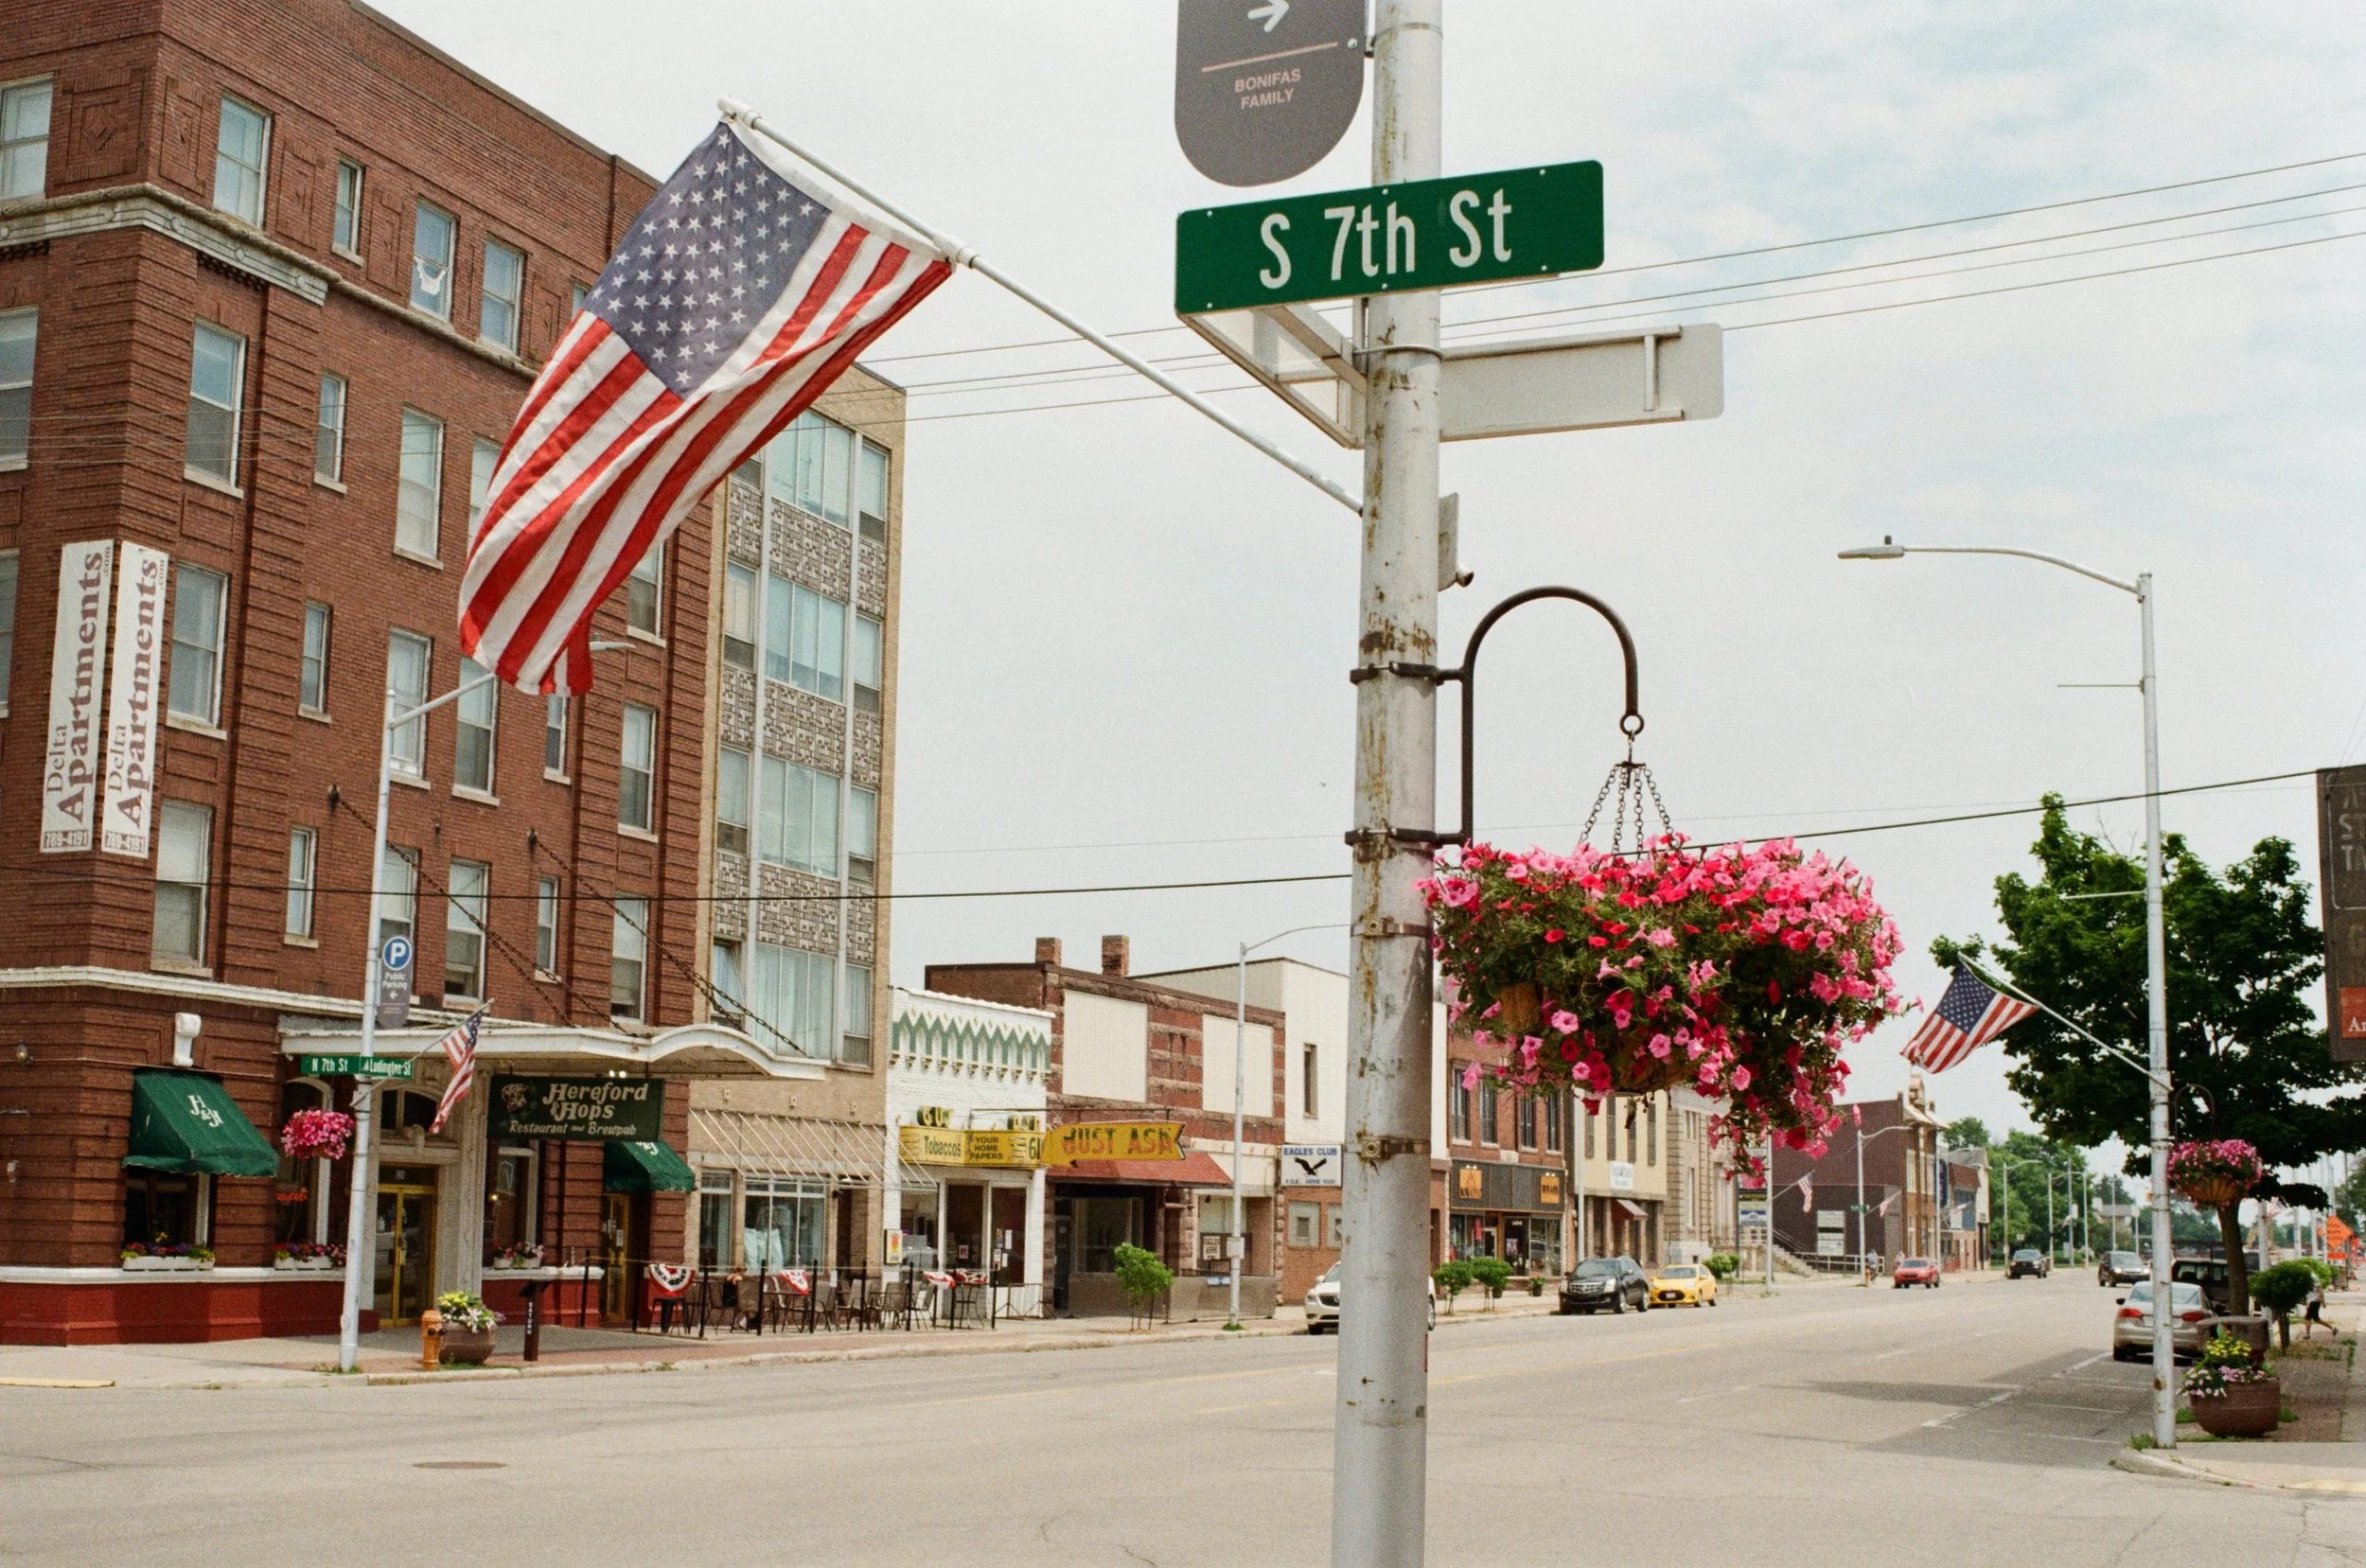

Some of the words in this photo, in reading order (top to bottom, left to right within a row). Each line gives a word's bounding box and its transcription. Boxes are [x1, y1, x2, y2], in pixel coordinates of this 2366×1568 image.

[1234, 68, 1301, 94] BONIFAS
[1241, 89, 1295, 111] FAMILY
[1259, 213, 1292, 290] S
[1324, 201, 1416, 282] 7th
[1448, 187, 1512, 269] St
[57, 552, 103, 824] Apartments
[117, 557, 159, 829] Apartments
[46, 724, 68, 794] Delta
[108, 724, 128, 793] Delta
[44, 830, 89, 850] 789-4191
[105, 830, 147, 853] 789-4191
[390, 943, 407, 965] P
[382, 980, 408, 990] Parking
[311, 1058, 319, 1072] N
[322, 1057, 335, 1072] 7th
[338, 1058, 348, 1072] St
[542, 1082, 649, 1105] Hereford
[509, 1119, 568, 1135] Restaurant
[588, 1121, 637, 1136] Brewpub
[924, 1135, 962, 1157] Tobaccos
[970, 1152, 1003, 1160] PAPERS
[1283, 1147, 1314, 1155] EAGLES
[1316, 1147, 1337, 1155] CLUB
